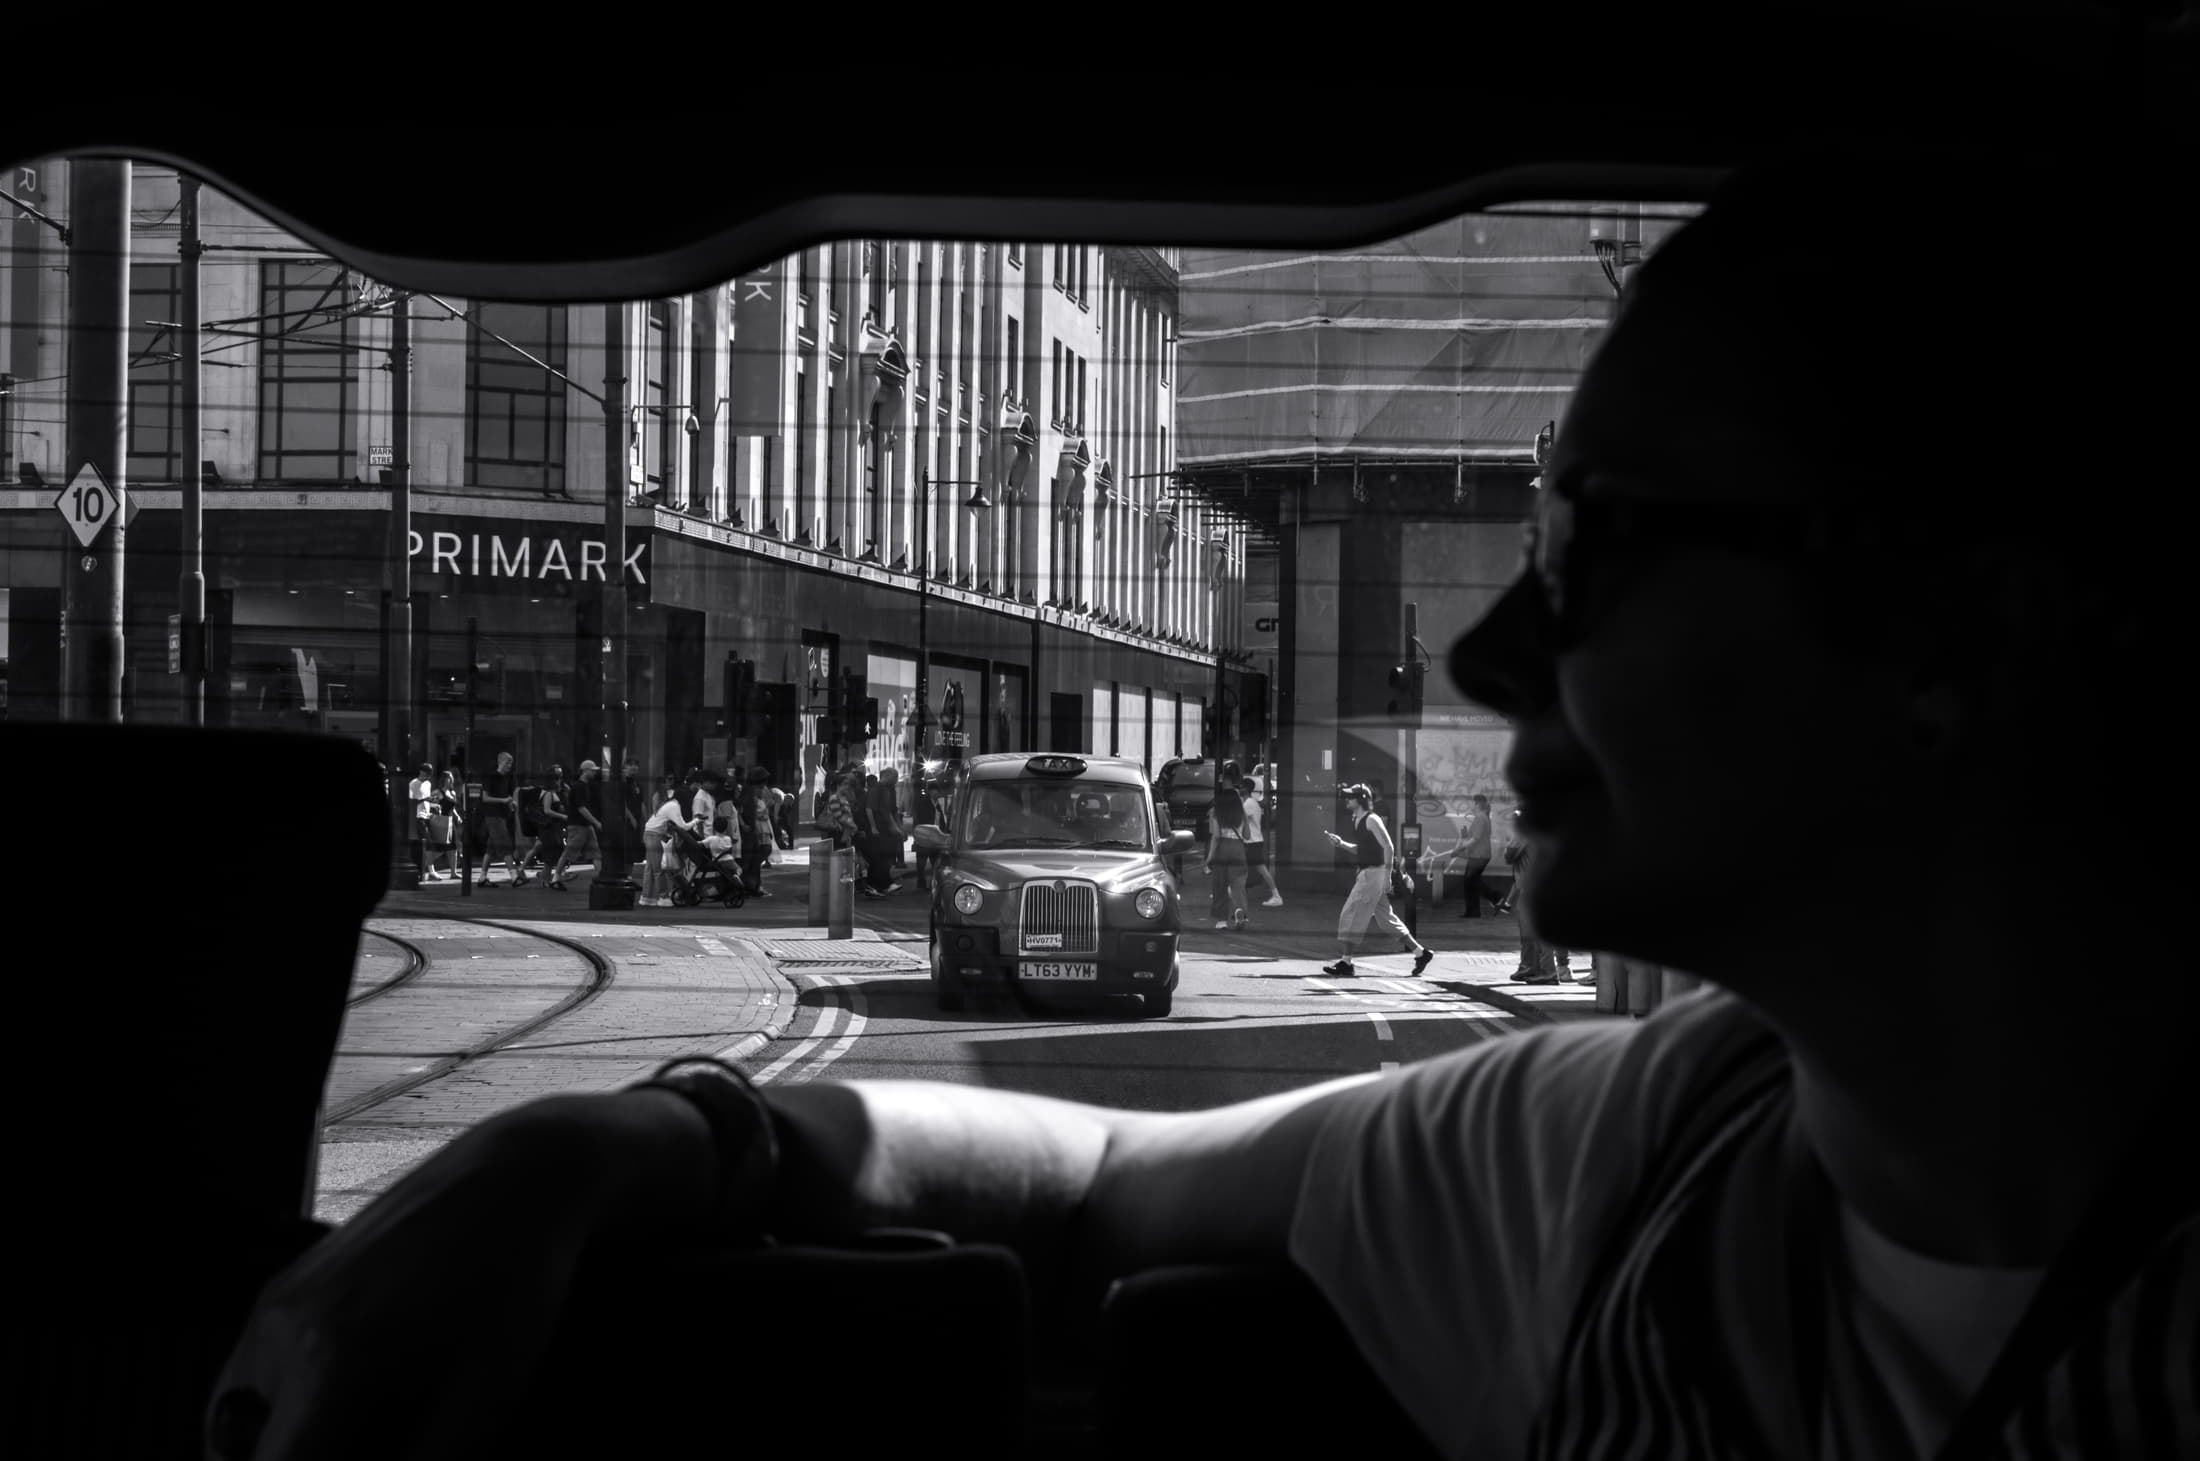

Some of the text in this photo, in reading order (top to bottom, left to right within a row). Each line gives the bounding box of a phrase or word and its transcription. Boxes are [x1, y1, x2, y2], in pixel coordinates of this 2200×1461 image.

[73, 487, 104, 523] 10
[409, 530, 647, 584] PRIMARK
[1041, 758, 1073, 769] TAXI
[1024, 963, 1091, 978] LT63 YYM
